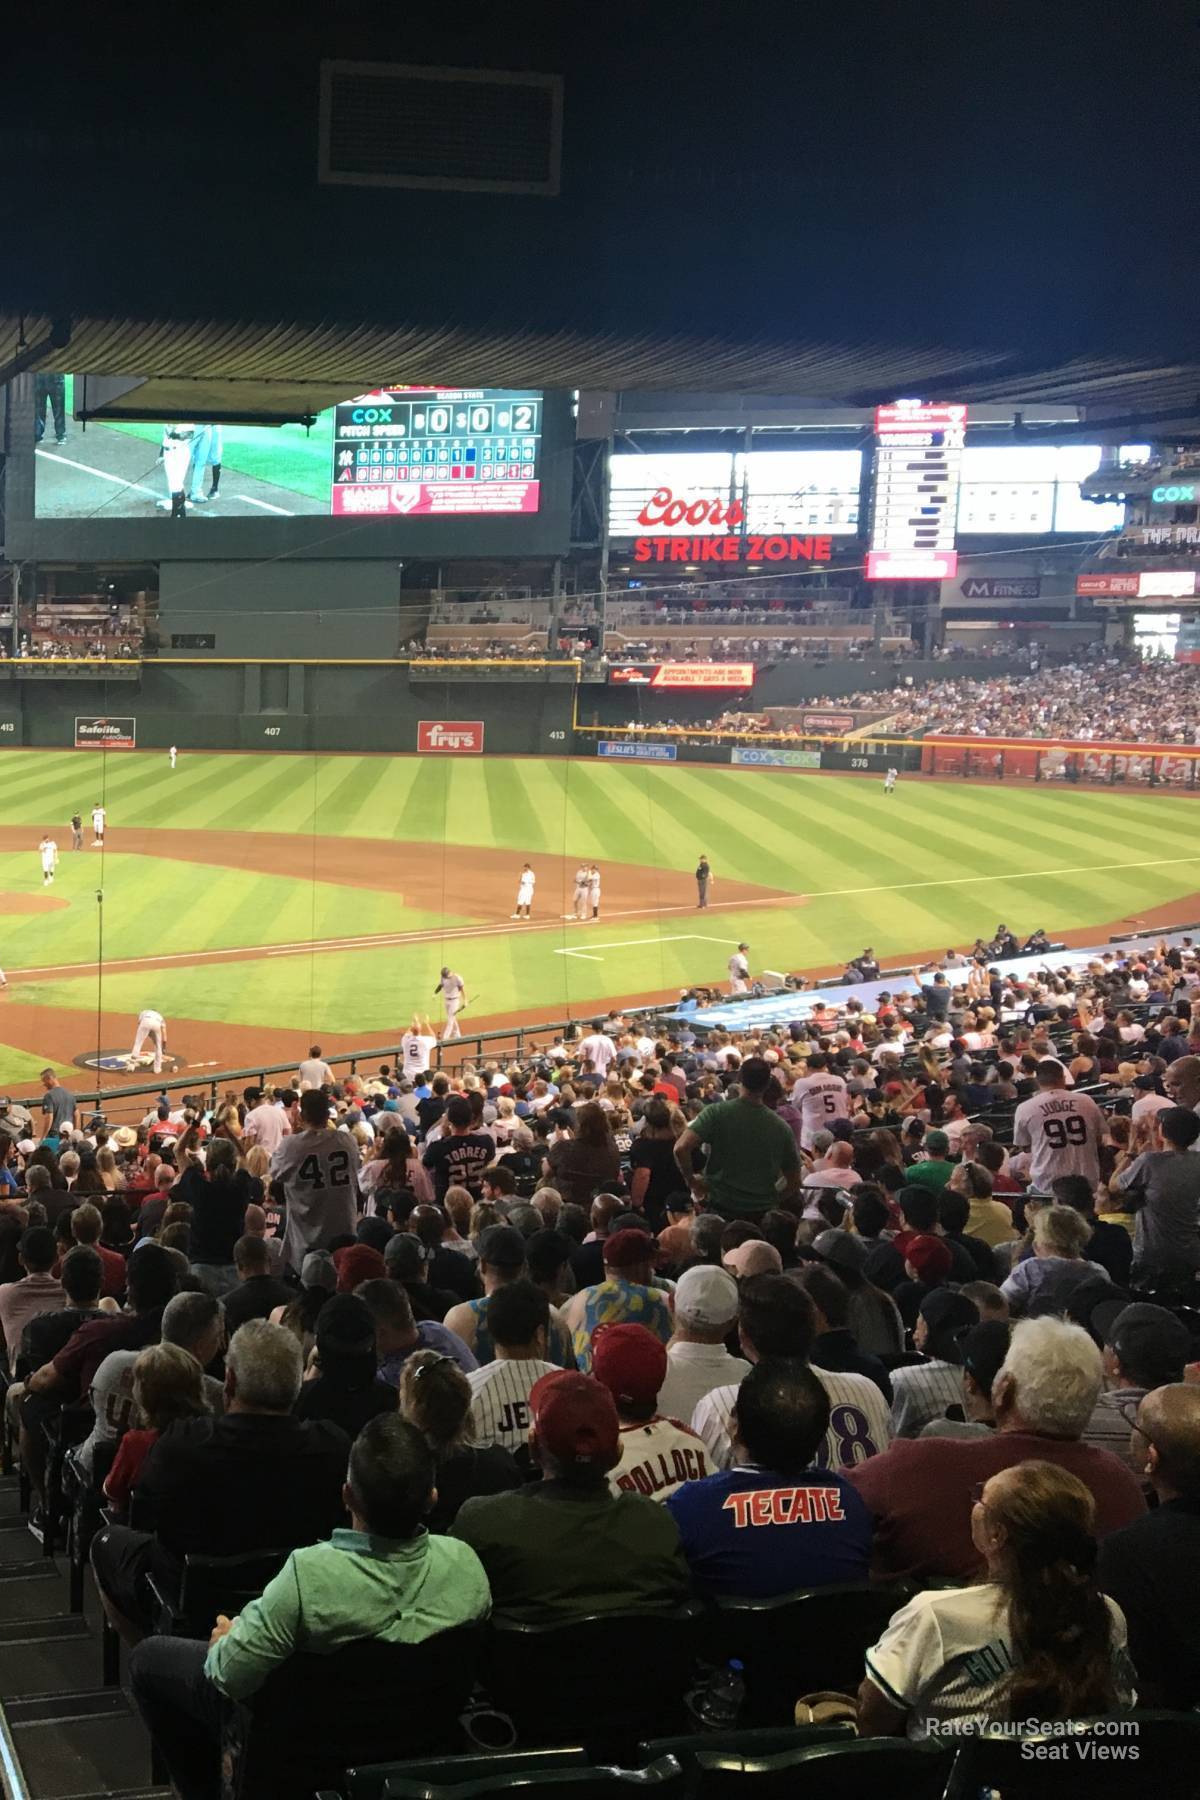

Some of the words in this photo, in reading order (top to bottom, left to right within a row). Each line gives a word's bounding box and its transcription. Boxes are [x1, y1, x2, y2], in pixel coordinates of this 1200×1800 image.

[352, 408, 392, 423] COX
[430, 408, 448, 432] 0
[455, 412, 467, 429] S
[471, 407, 490, 431] 0
[514, 406, 532, 430] 2
[1152, 485, 1195, 502] COX
[636, 487, 746, 529] Coors
[1142, 528, 1172, 545] THE
[633, 536, 740, 562] STRIKE
[745, 535, 833, 561] ZONE
[992, 583, 1037, 596] FITNESS
[0, 723, 14, 732] 413
[78, 725, 121, 734] Safelite
[264, 727, 281, 736] 407
[549, 730, 565, 740] 413
[426, 724, 475, 749] fry's
[742, 751, 768, 762] COX
[783, 752, 810, 764] COX
[851, 758, 869, 768] 376
[409, 1044, 419, 1057] 2
[823, 1094, 836, 1114] 5
[1038, 1099, 1077, 1117] JUDGE
[1043, 1115, 1087, 1149] 99
[444, 1146, 487, 1164] TORRES
[299, 1150, 350, 1189] 42
[616, 1449, 707, 1494] POLLOCK
[723, 1487, 847, 1528] TECATE
